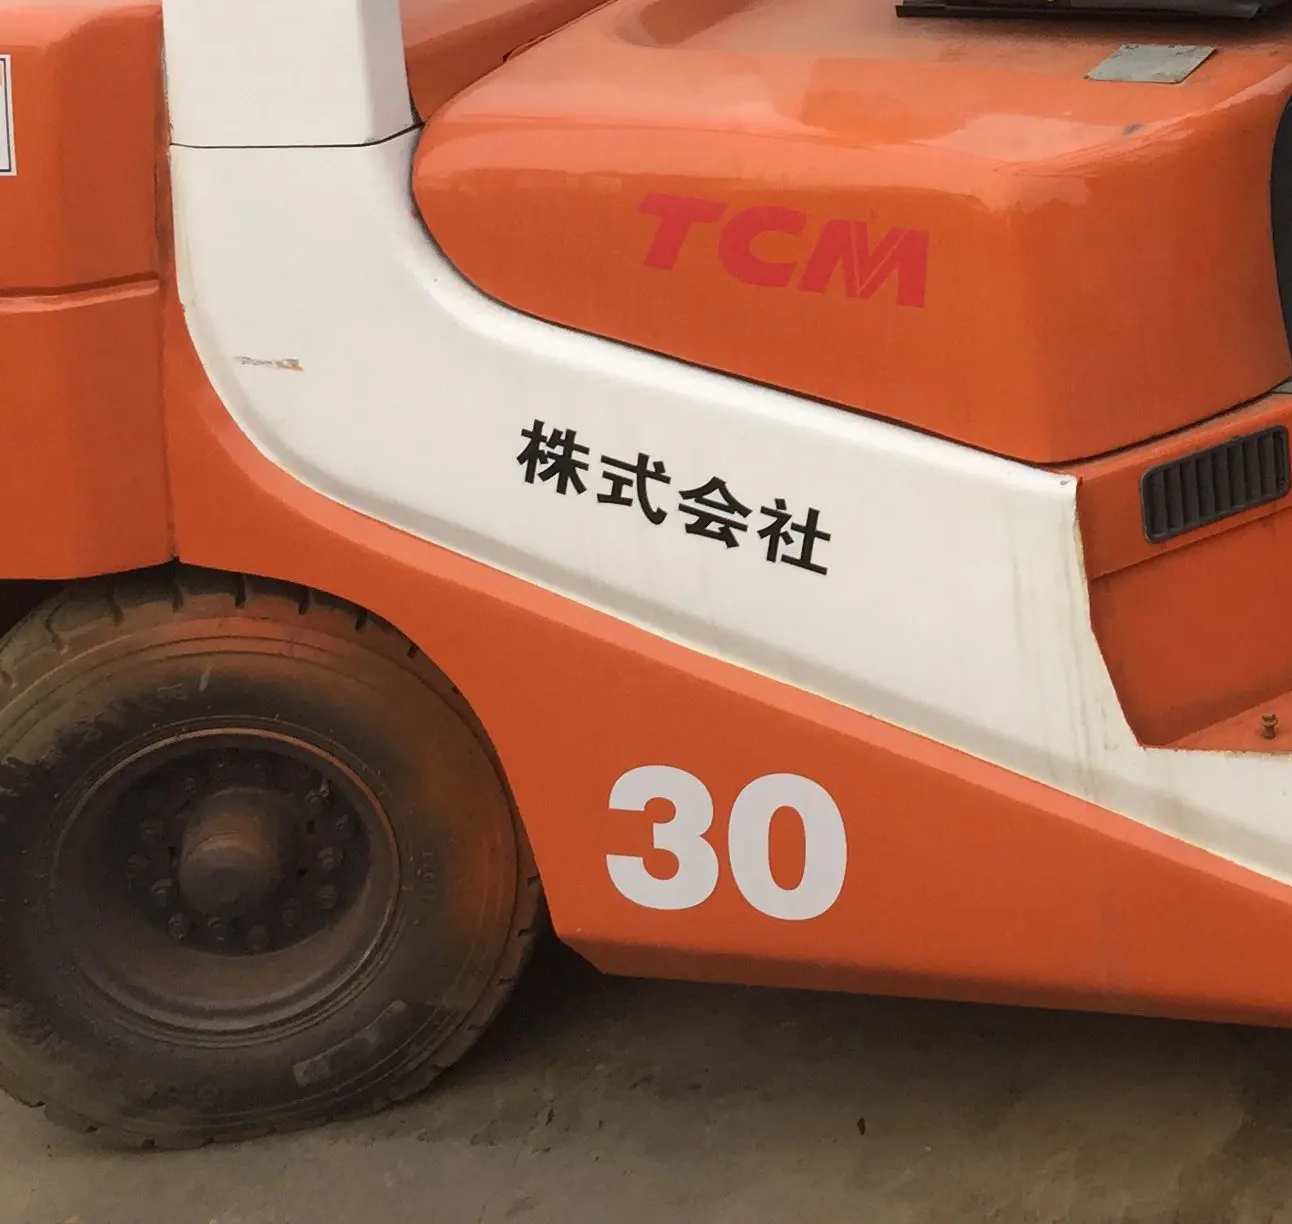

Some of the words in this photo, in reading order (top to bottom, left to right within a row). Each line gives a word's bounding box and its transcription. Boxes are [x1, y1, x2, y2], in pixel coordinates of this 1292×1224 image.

[637, 192, 930, 309] TCM
[516, 418, 832, 576] 株式会社
[605, 764, 848, 921] 30
